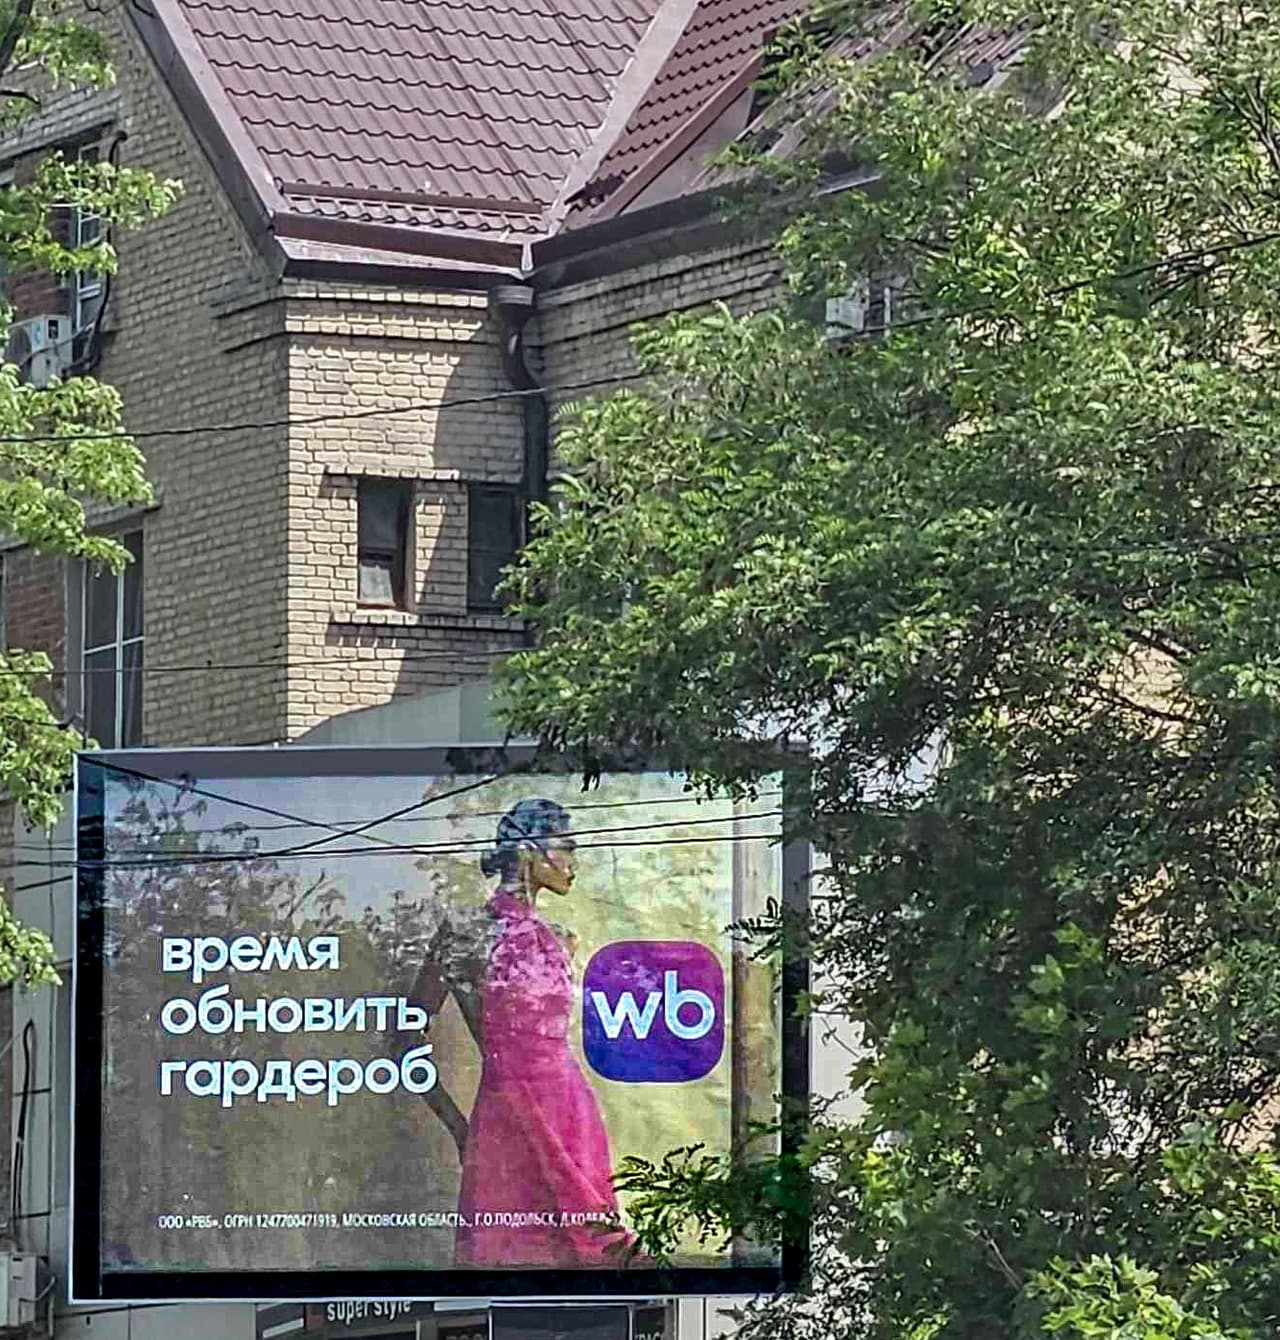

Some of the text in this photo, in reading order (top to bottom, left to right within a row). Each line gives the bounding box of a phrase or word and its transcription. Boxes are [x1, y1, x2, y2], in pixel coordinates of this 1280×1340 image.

[162, 936, 340, 983] время
[161, 985, 428, 1034] обновить
[591, 972, 715, 1040] wb
[161, 1045, 437, 1106] гардероб
[158, 1215, 183, 1229] ООО
[343, 1213, 417, 1228] МОСКОВСКАЯ
